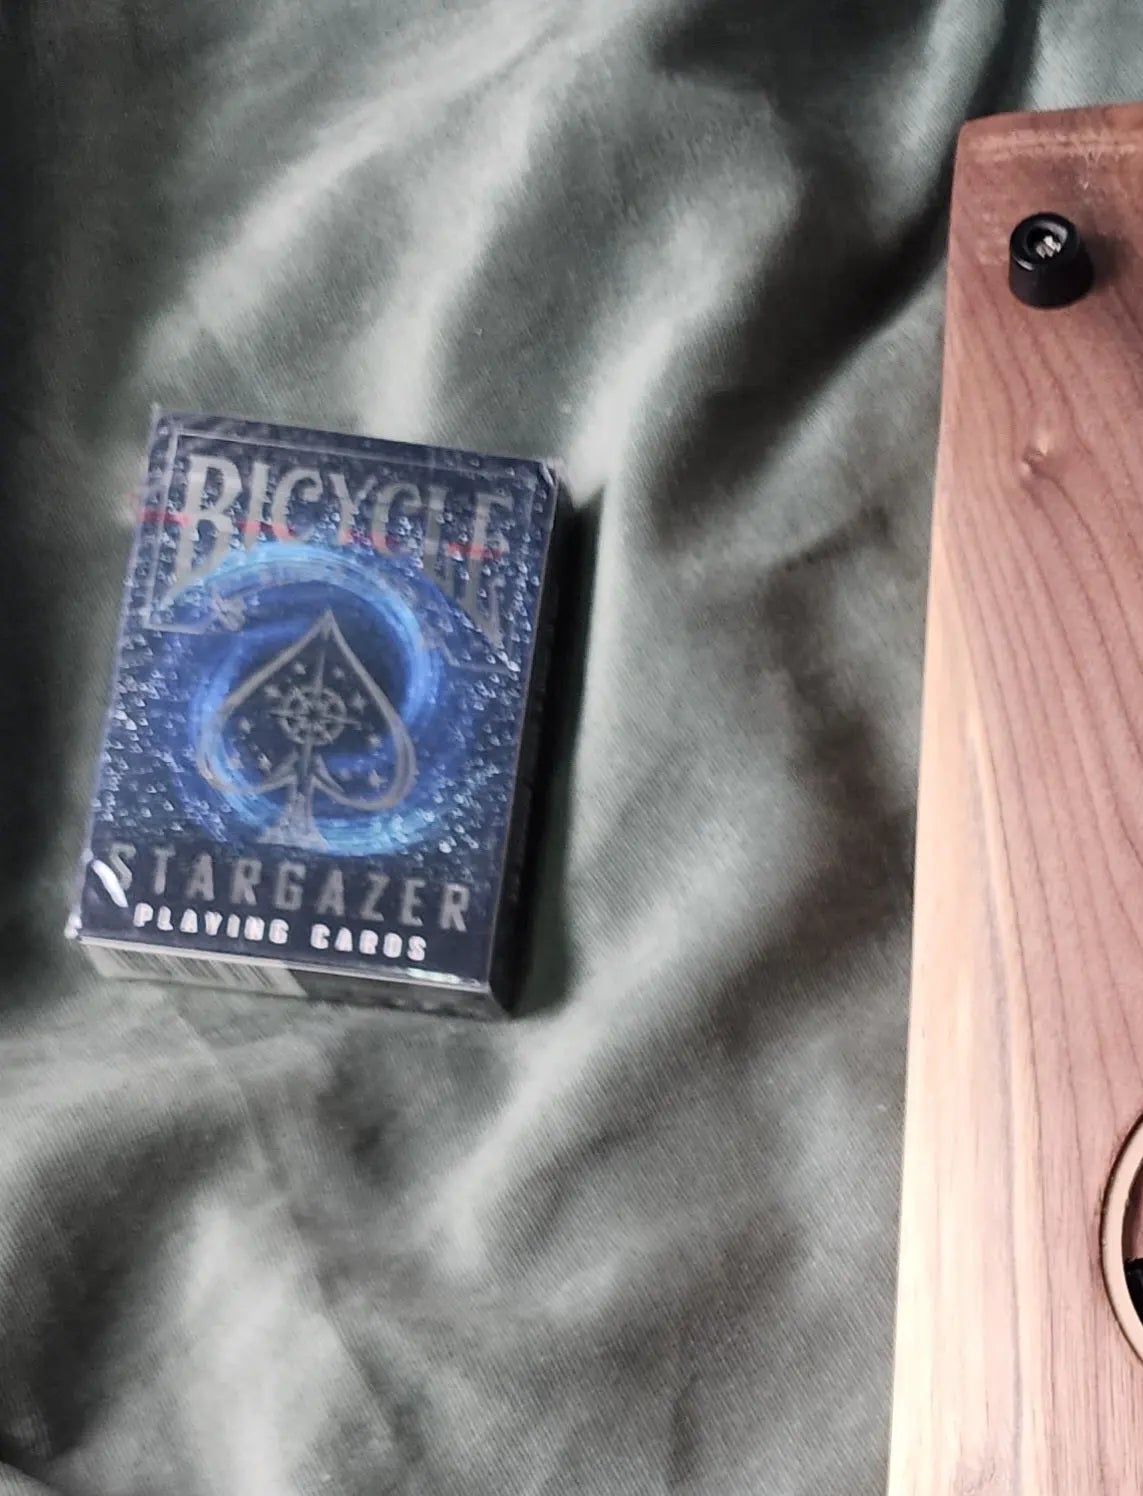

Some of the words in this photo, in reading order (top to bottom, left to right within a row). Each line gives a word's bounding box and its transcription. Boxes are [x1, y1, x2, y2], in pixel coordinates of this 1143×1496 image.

[165, 453, 515, 645] BICYCLE
[104, 841, 471, 933] STARGAZER
[133, 902, 290, 945] PLAYING
[310, 922, 427, 962] CARDS
